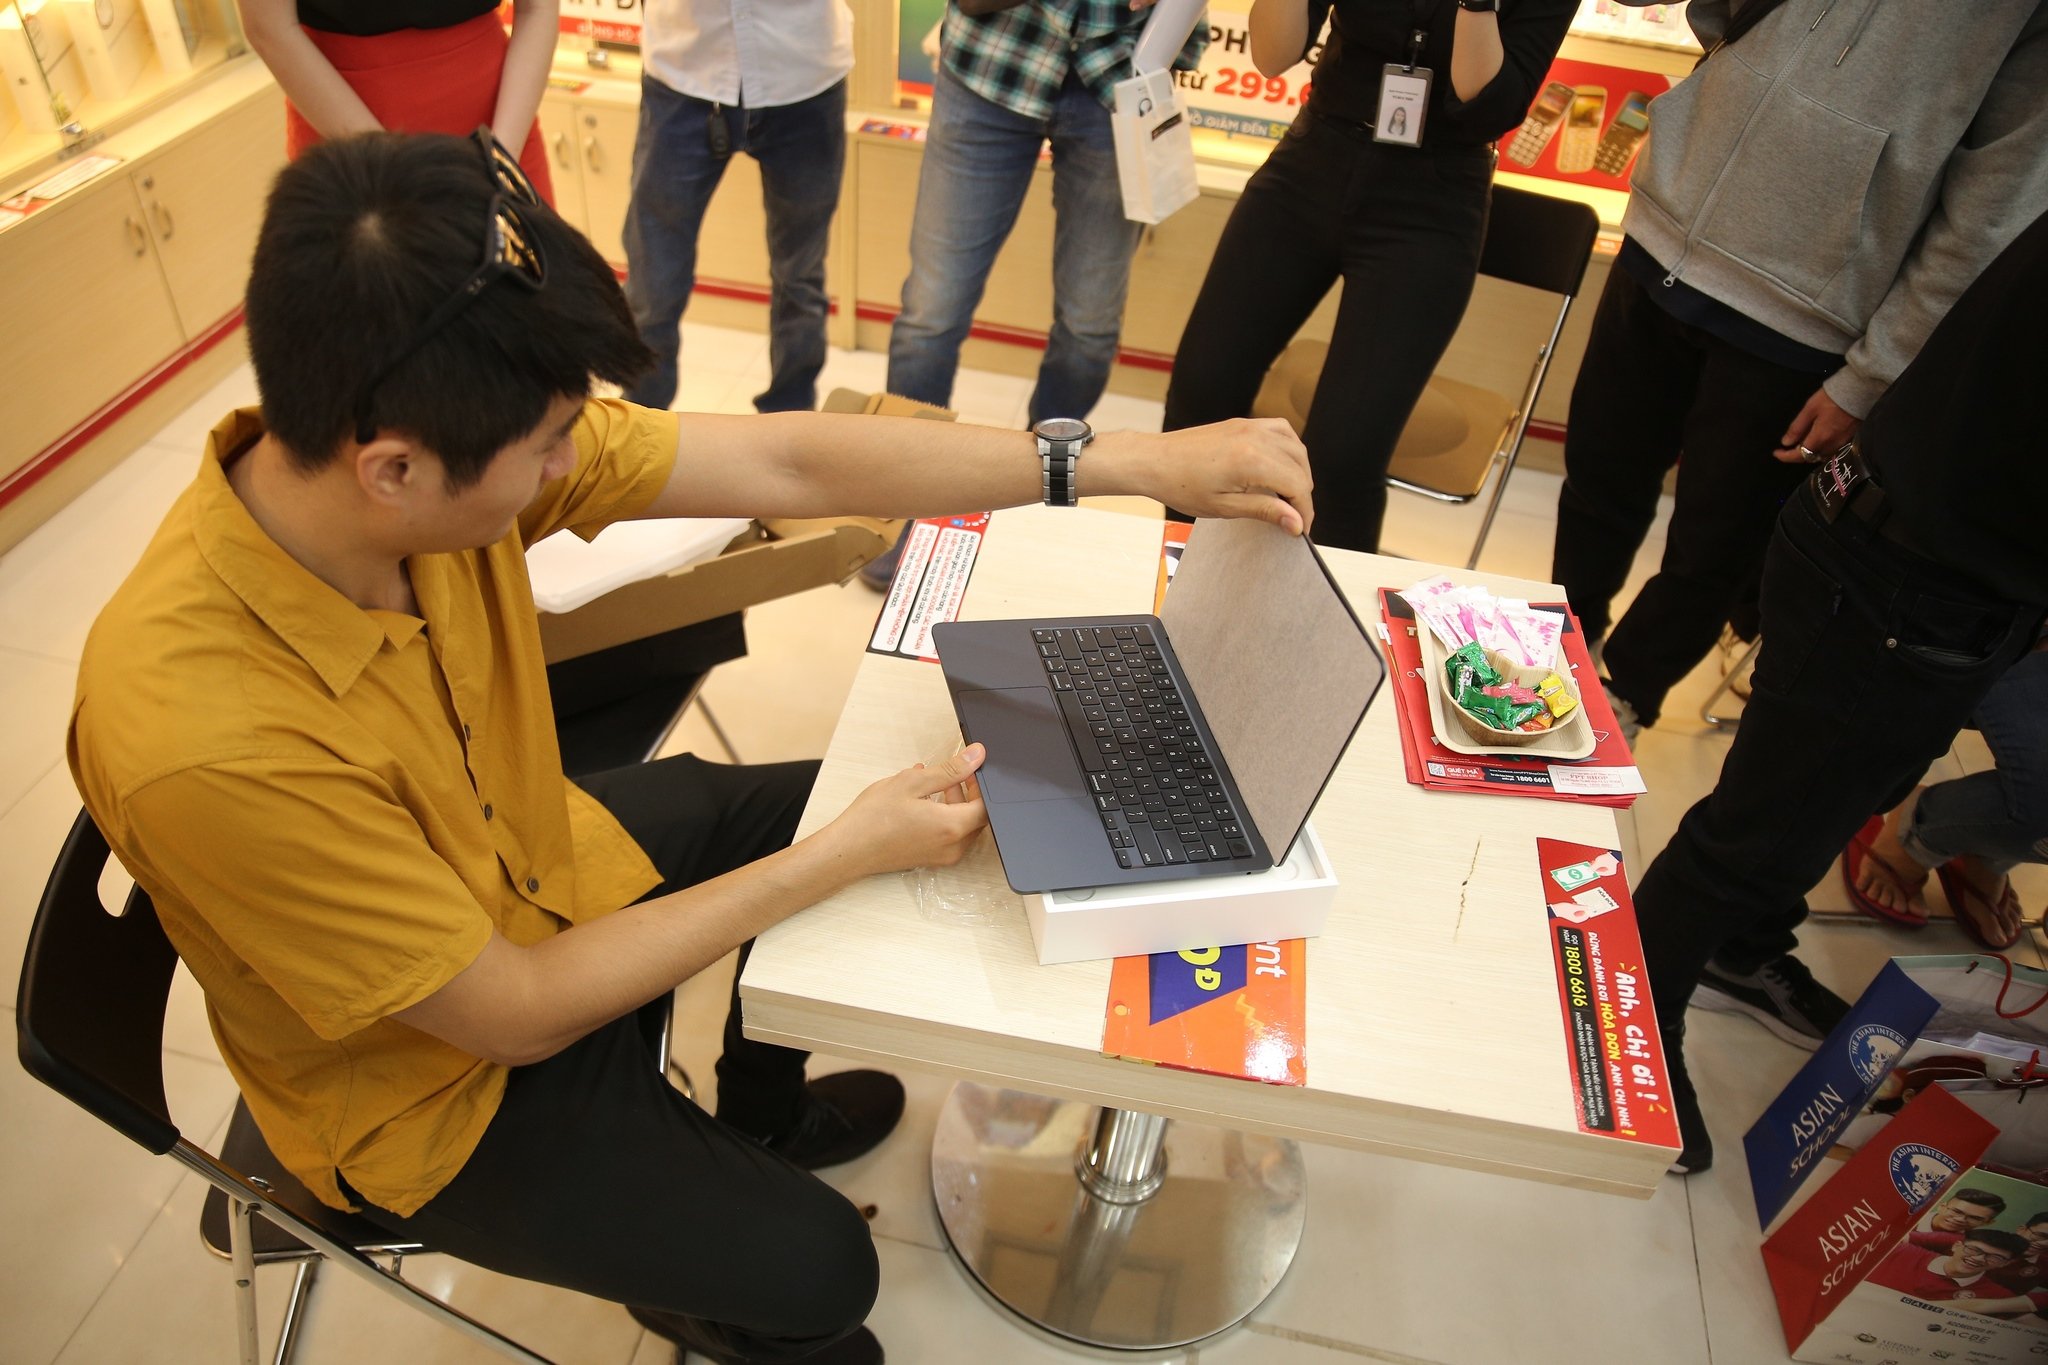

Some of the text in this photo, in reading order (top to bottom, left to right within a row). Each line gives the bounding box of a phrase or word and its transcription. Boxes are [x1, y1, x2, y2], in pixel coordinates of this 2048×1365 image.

[1565, 945, 1588, 1007] 1800 6616
[1593, 957, 1606, 984] ĐÁNH
[1606, 1030, 1621, 1060] ĐƠN
[1615, 971, 1640, 1017] Anh,
[1632, 1063, 1656, 1087] ơi
[1790, 1105, 1850, 1178] SCHOOL
[1791, 1083, 1844, 1148] ASIAN
[1896, 1145, 1919, 1159] ASIAN
[1818, 1198, 1882, 1263] ASIAN
[1820, 1224, 1891, 1296] SCHOOL
